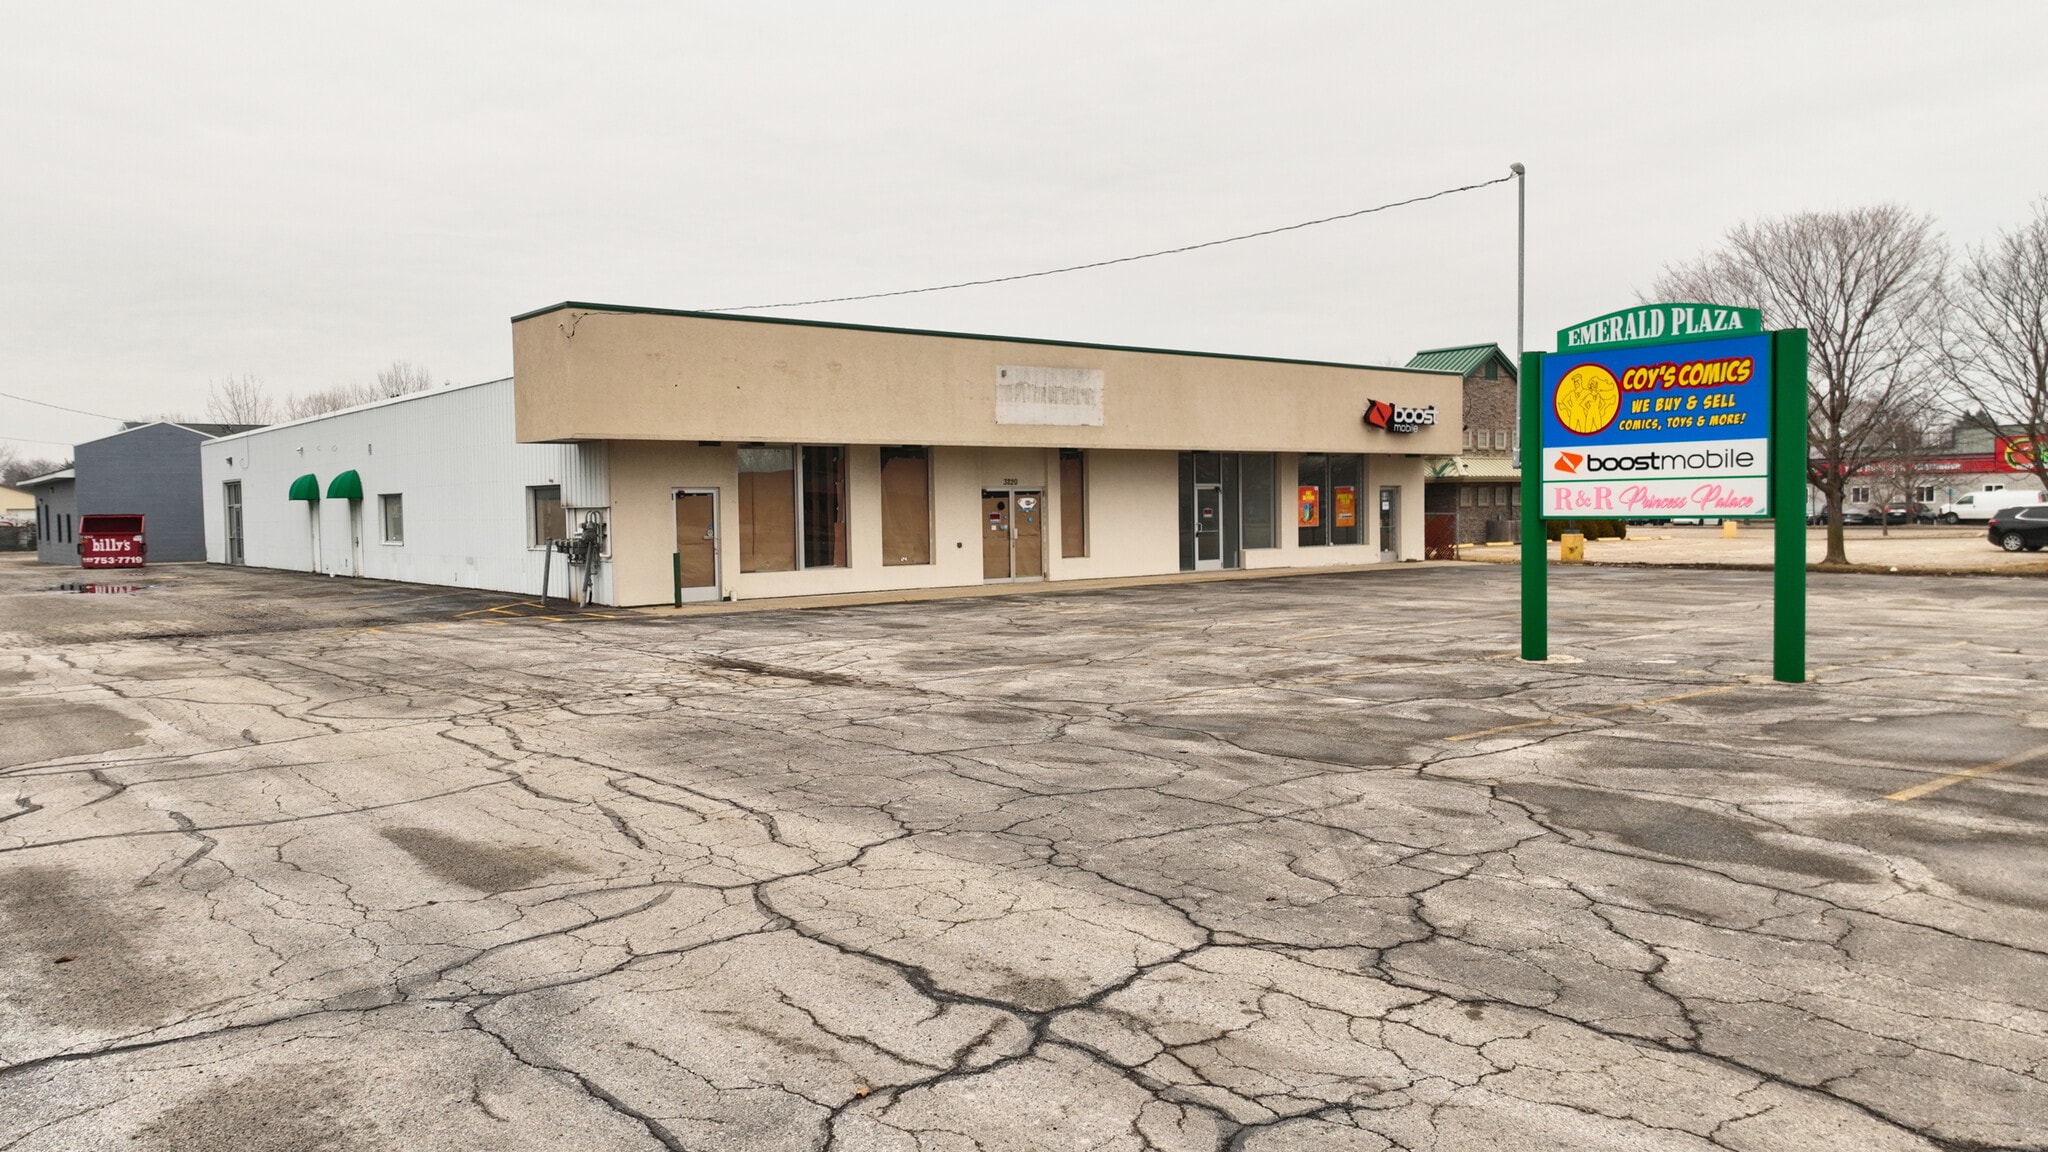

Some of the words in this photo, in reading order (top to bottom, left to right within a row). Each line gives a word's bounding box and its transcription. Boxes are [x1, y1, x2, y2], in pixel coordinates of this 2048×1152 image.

[1567, 308, 1665, 347] EMERALD
[1671, 307, 1743, 336] PLAZA
[1622, 365, 1676, 390] COY'S
[1678, 359, 1751, 386] COMICS
[1631, 399, 1651, 414] WE
[1655, 397, 1682, 412] BUY
[1686, 395, 1698, 411] &
[1703, 393, 1736, 409] SELL
[1394, 404, 1439, 425] boost
[1619, 418, 1662, 431] COMICS,
[1667, 416, 1693, 428] TOYS
[1696, 415, 1705, 427] &
[1709, 413, 1747, 426] MORE!
[1393, 423, 1419, 433] mobile
[1003, 478, 1019, 486] 3220
[1618, 485, 1688, 512] Princess
[1690, 483, 1754, 511] Palace
[92, 538, 131, 552] billy's
[94, 556, 143, 565] 753-7719
